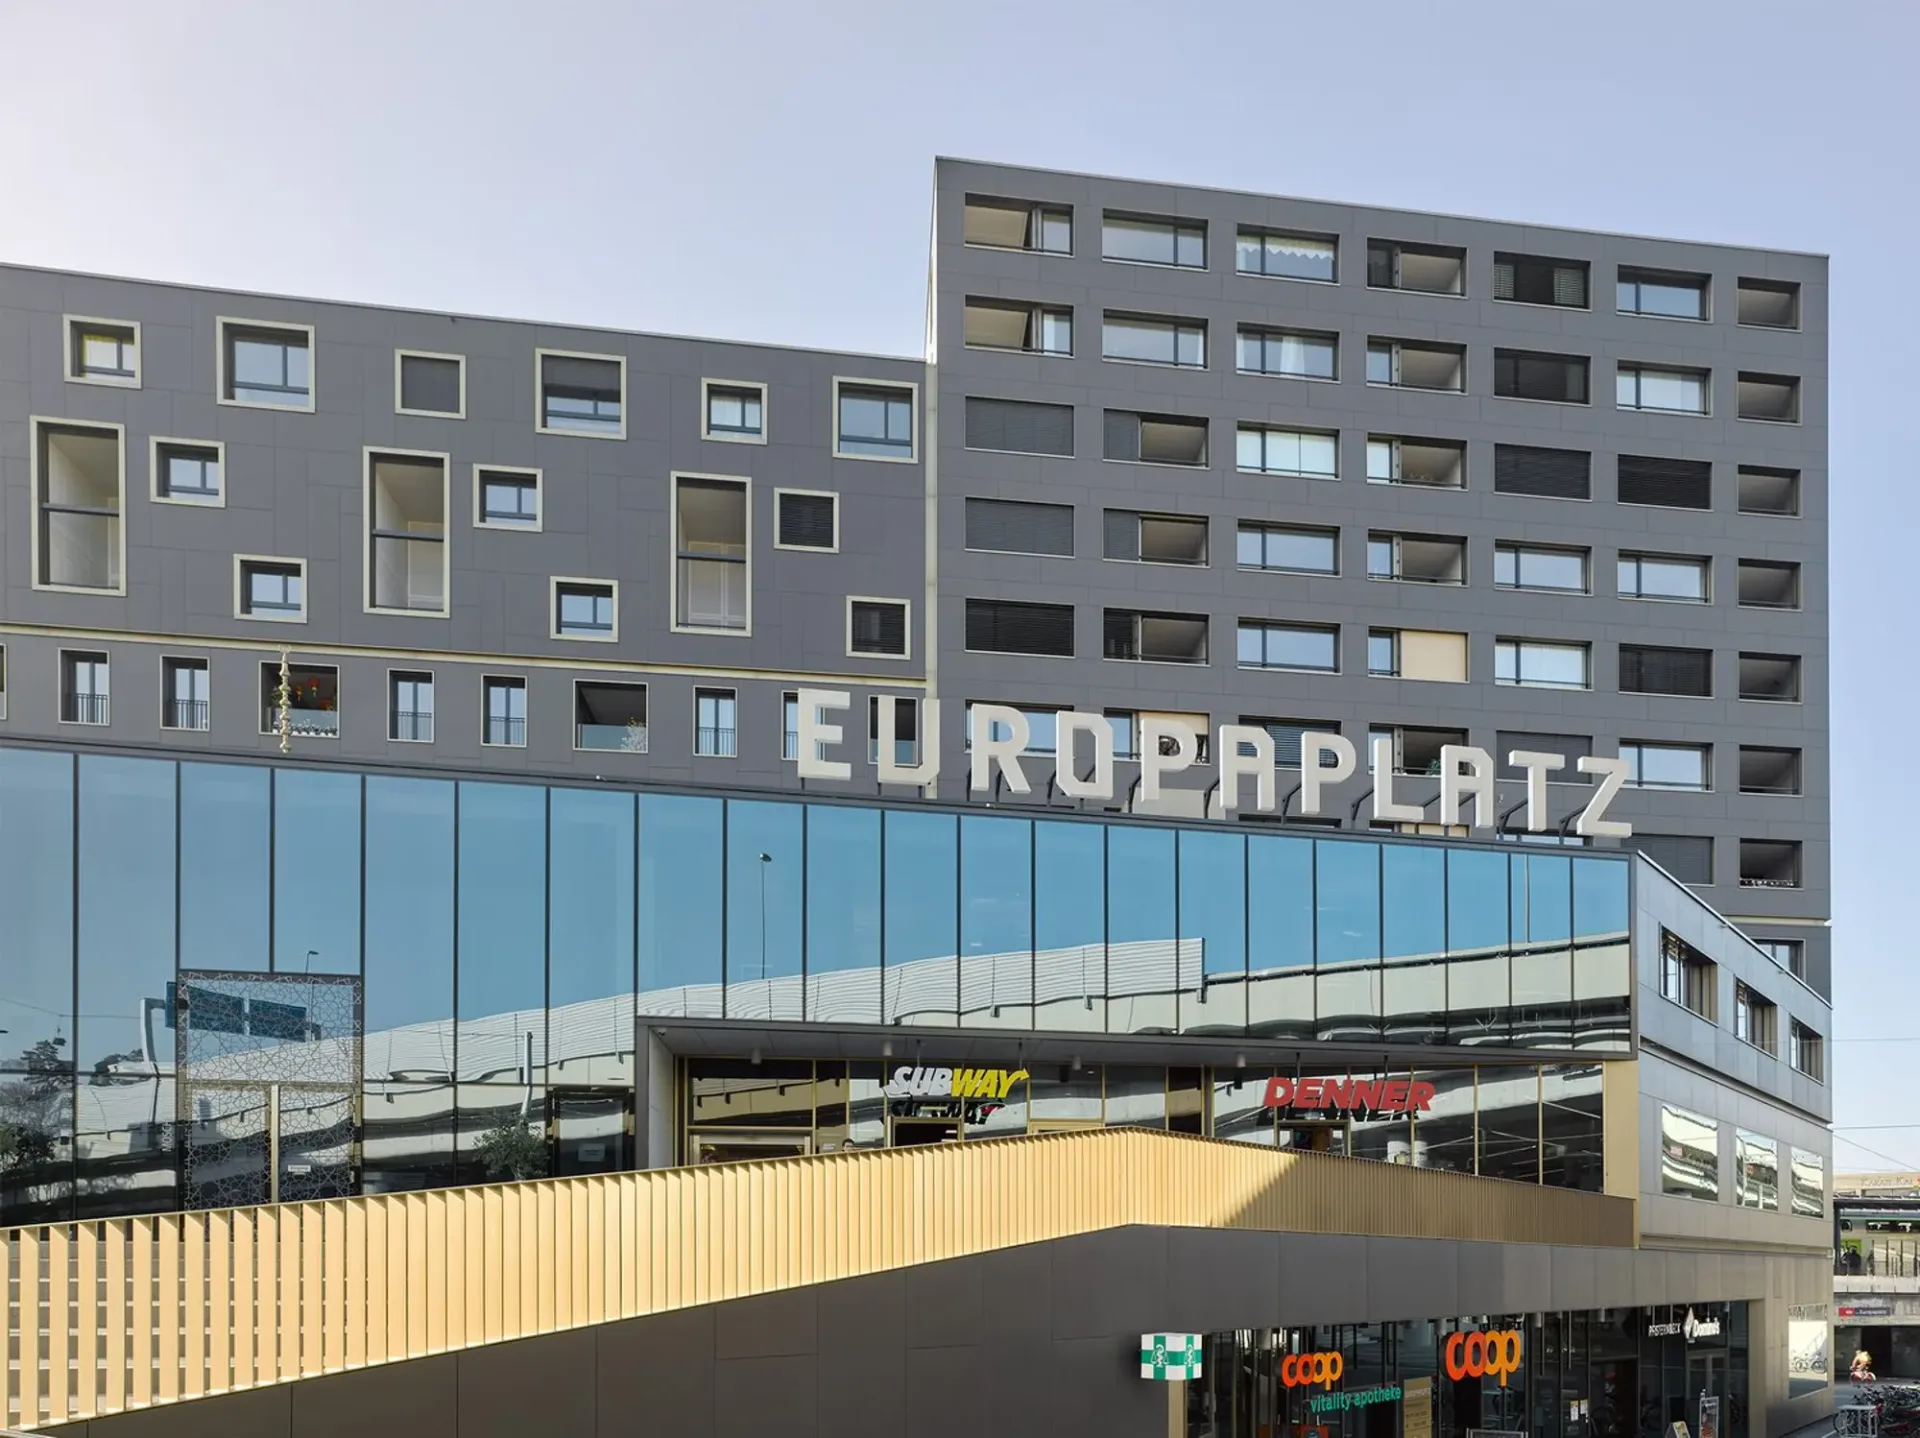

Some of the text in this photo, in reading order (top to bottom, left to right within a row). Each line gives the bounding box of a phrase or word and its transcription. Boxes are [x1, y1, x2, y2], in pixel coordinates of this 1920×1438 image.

[797, 688, 1633, 839] EUROPAPLATZ
[880, 1066, 1031, 1099] SUBWAY
[1263, 1076, 1436, 1112] DENNER
[1282, 1351, 1343, 1391] coop
[1445, 1329, 1521, 1387] coop
[1310, 1385, 1402, 1413] vitality apotheke
